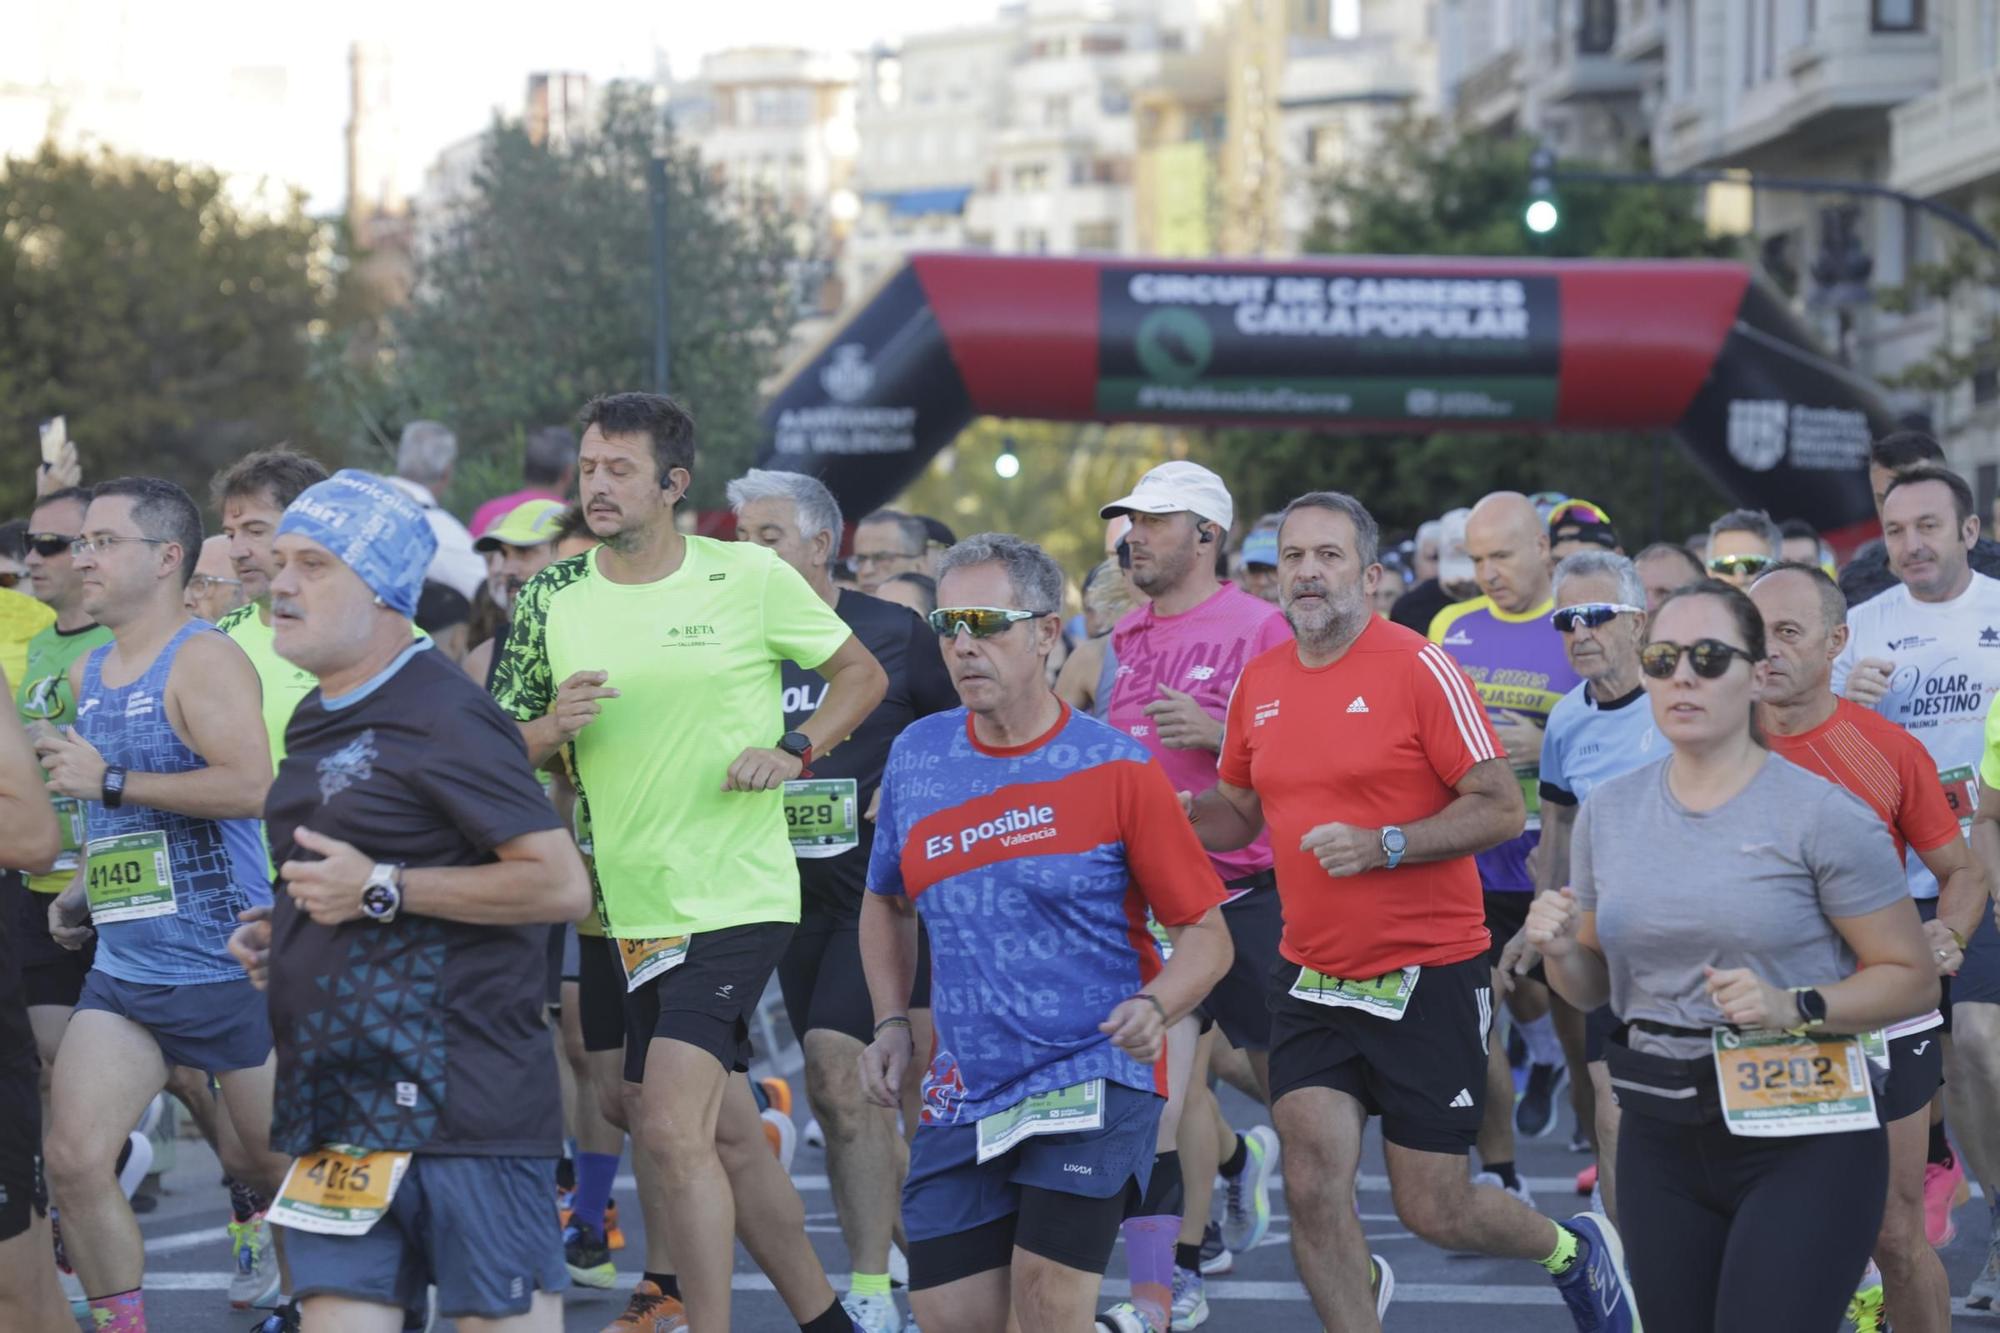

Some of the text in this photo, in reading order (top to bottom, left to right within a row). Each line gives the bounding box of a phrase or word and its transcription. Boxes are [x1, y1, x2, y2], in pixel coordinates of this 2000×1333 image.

[1129, 273, 1526, 308] CIRCUIT DE CARRERES
[685, 625, 715, 635] RETA
[1971, 683, 1982, 692] es
[1901, 693, 1981, 716] mi DESTINO
[926, 805, 1054, 860] Es posible
[1000, 827, 1057, 847] Valencia
[90, 860, 142, 889] 4140
[1738, 1056, 1835, 1091] 3202
